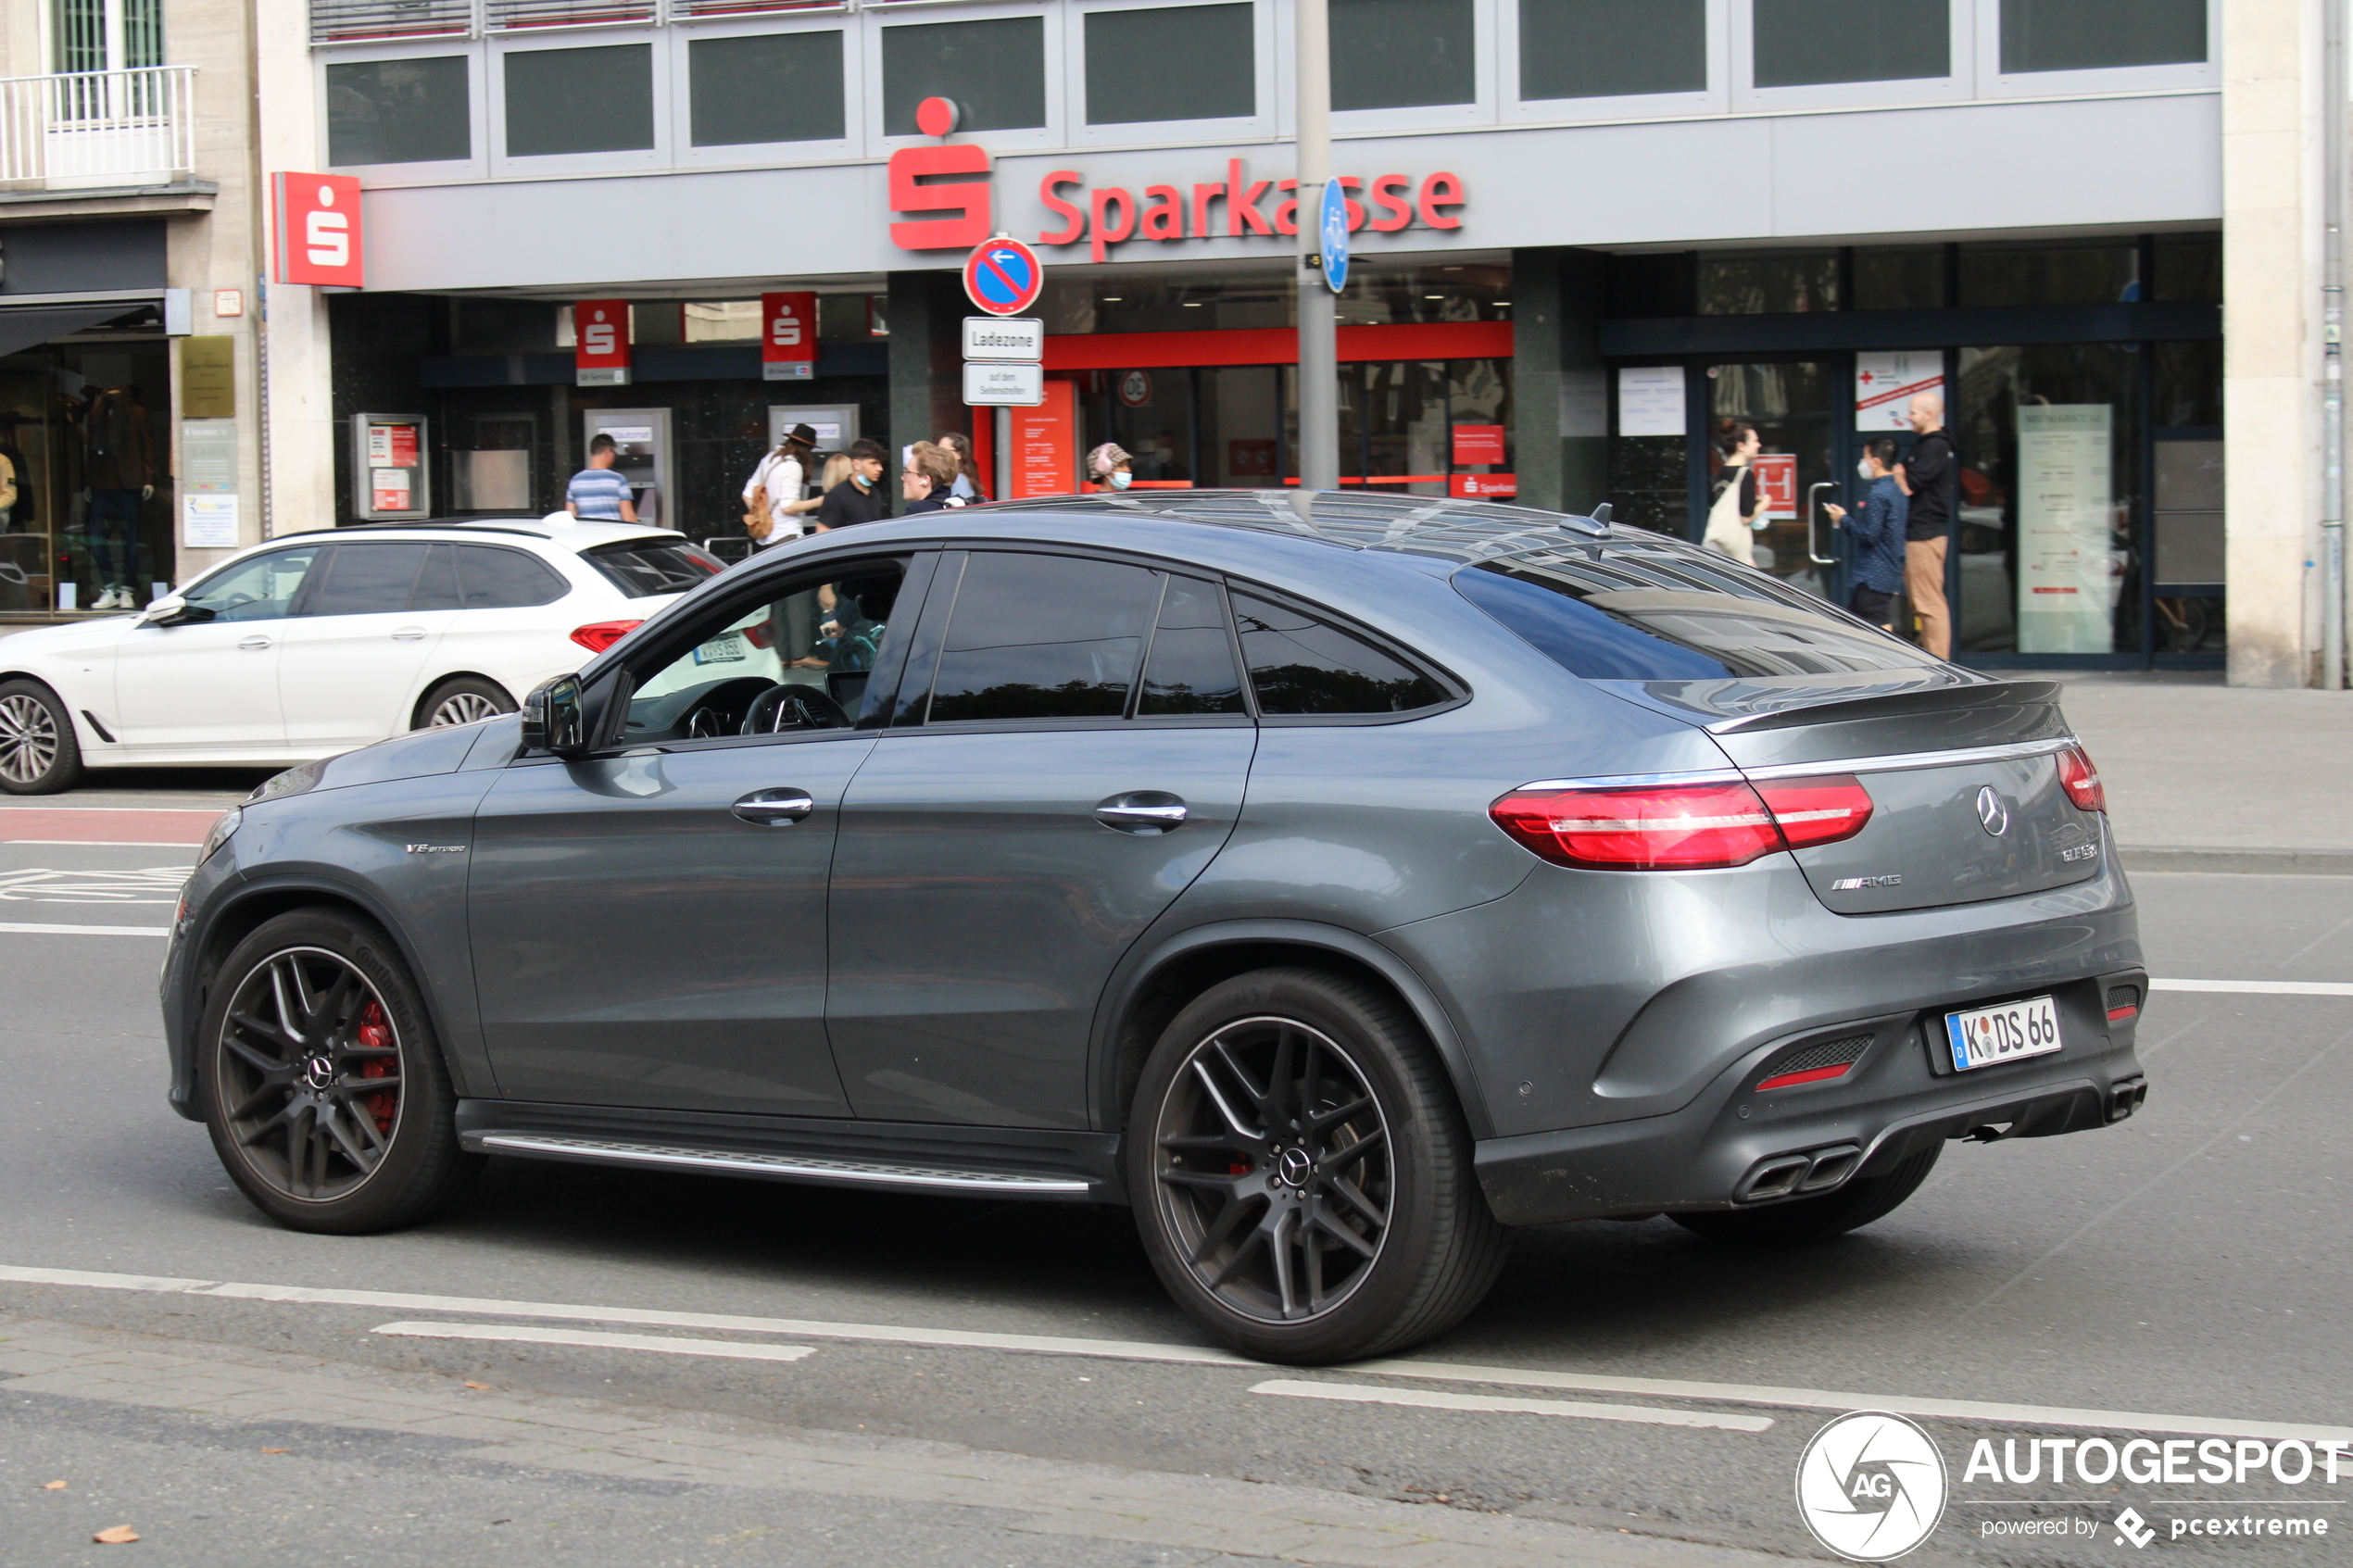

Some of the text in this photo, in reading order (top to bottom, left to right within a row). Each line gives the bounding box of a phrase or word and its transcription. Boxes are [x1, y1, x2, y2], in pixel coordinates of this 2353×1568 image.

[1038, 158, 1465, 263] Sparkasse
[973, 332, 1033, 347] Ladezone
[1856, 874, 1902, 888] AMG
[2028, 1005, 2055, 1046] 66
